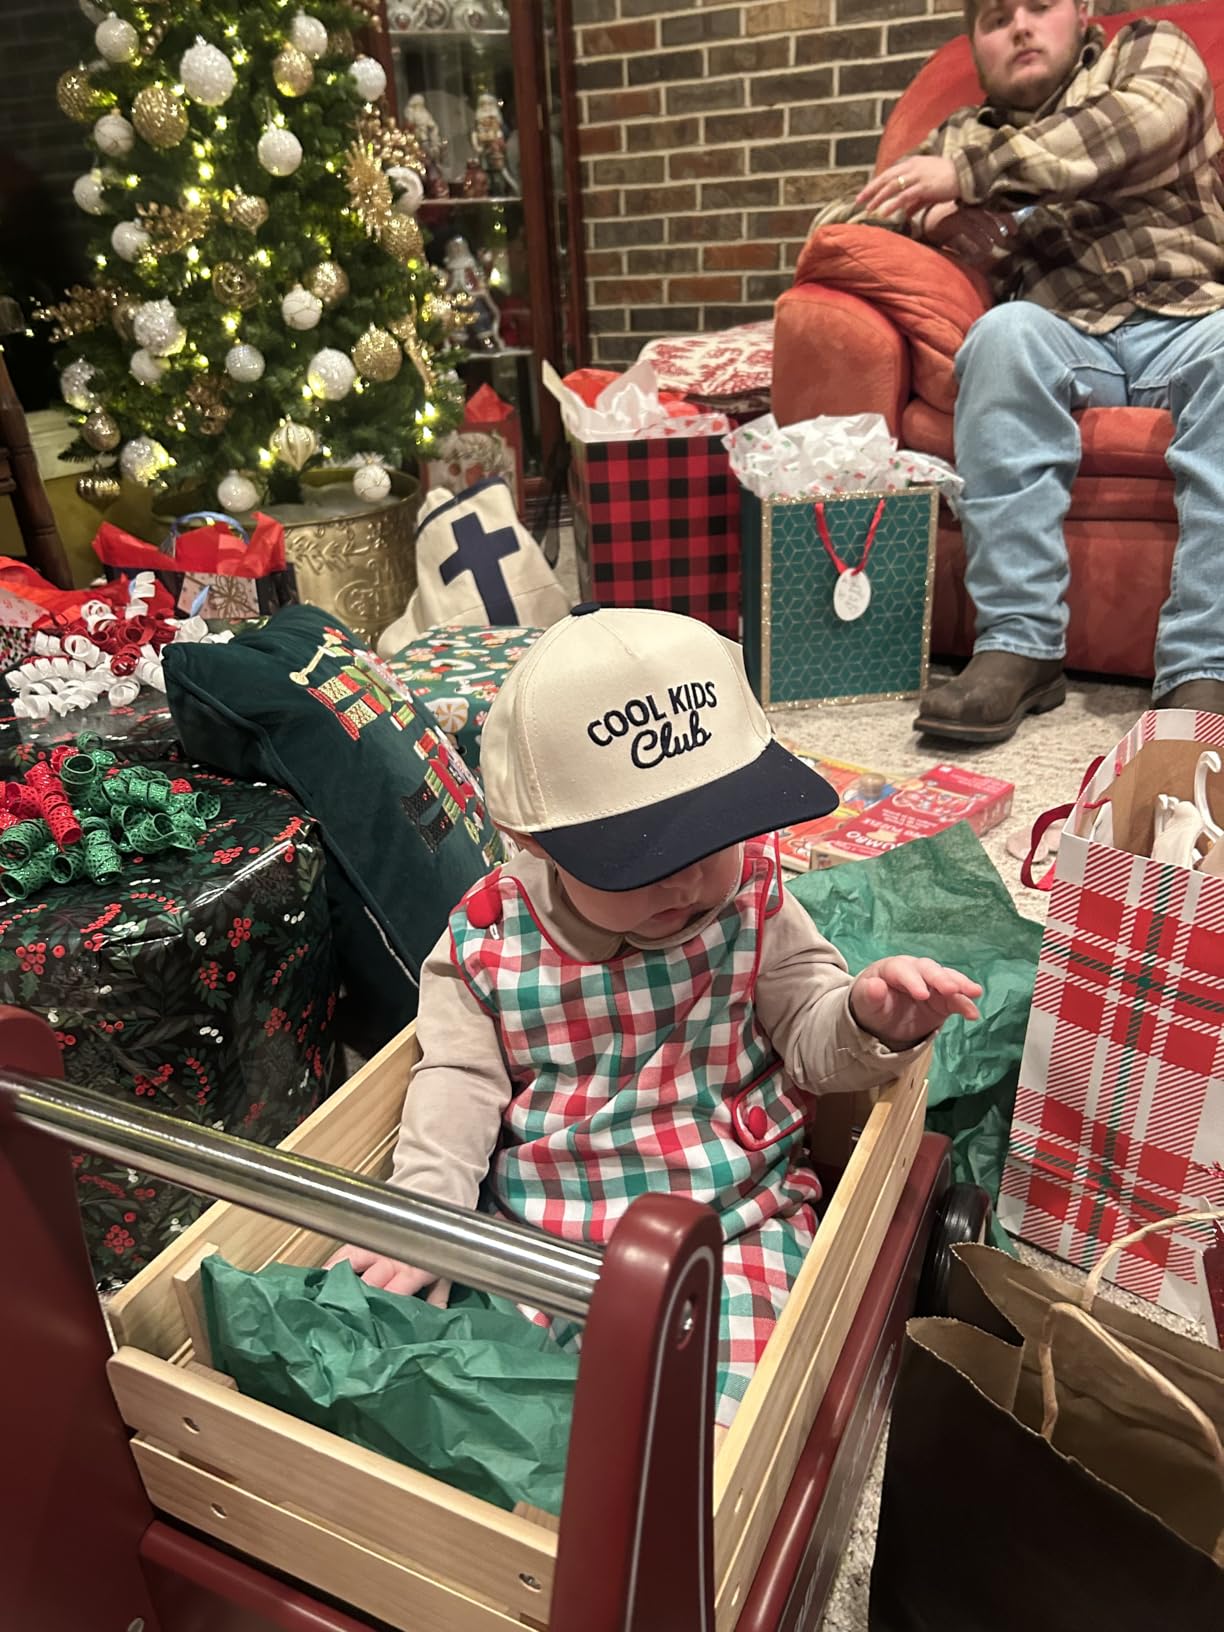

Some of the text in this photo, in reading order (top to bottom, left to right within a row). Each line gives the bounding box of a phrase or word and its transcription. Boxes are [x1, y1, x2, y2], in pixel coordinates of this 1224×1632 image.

[587, 681, 717, 747] COOL KIDS
[630, 709, 712, 769] Club
